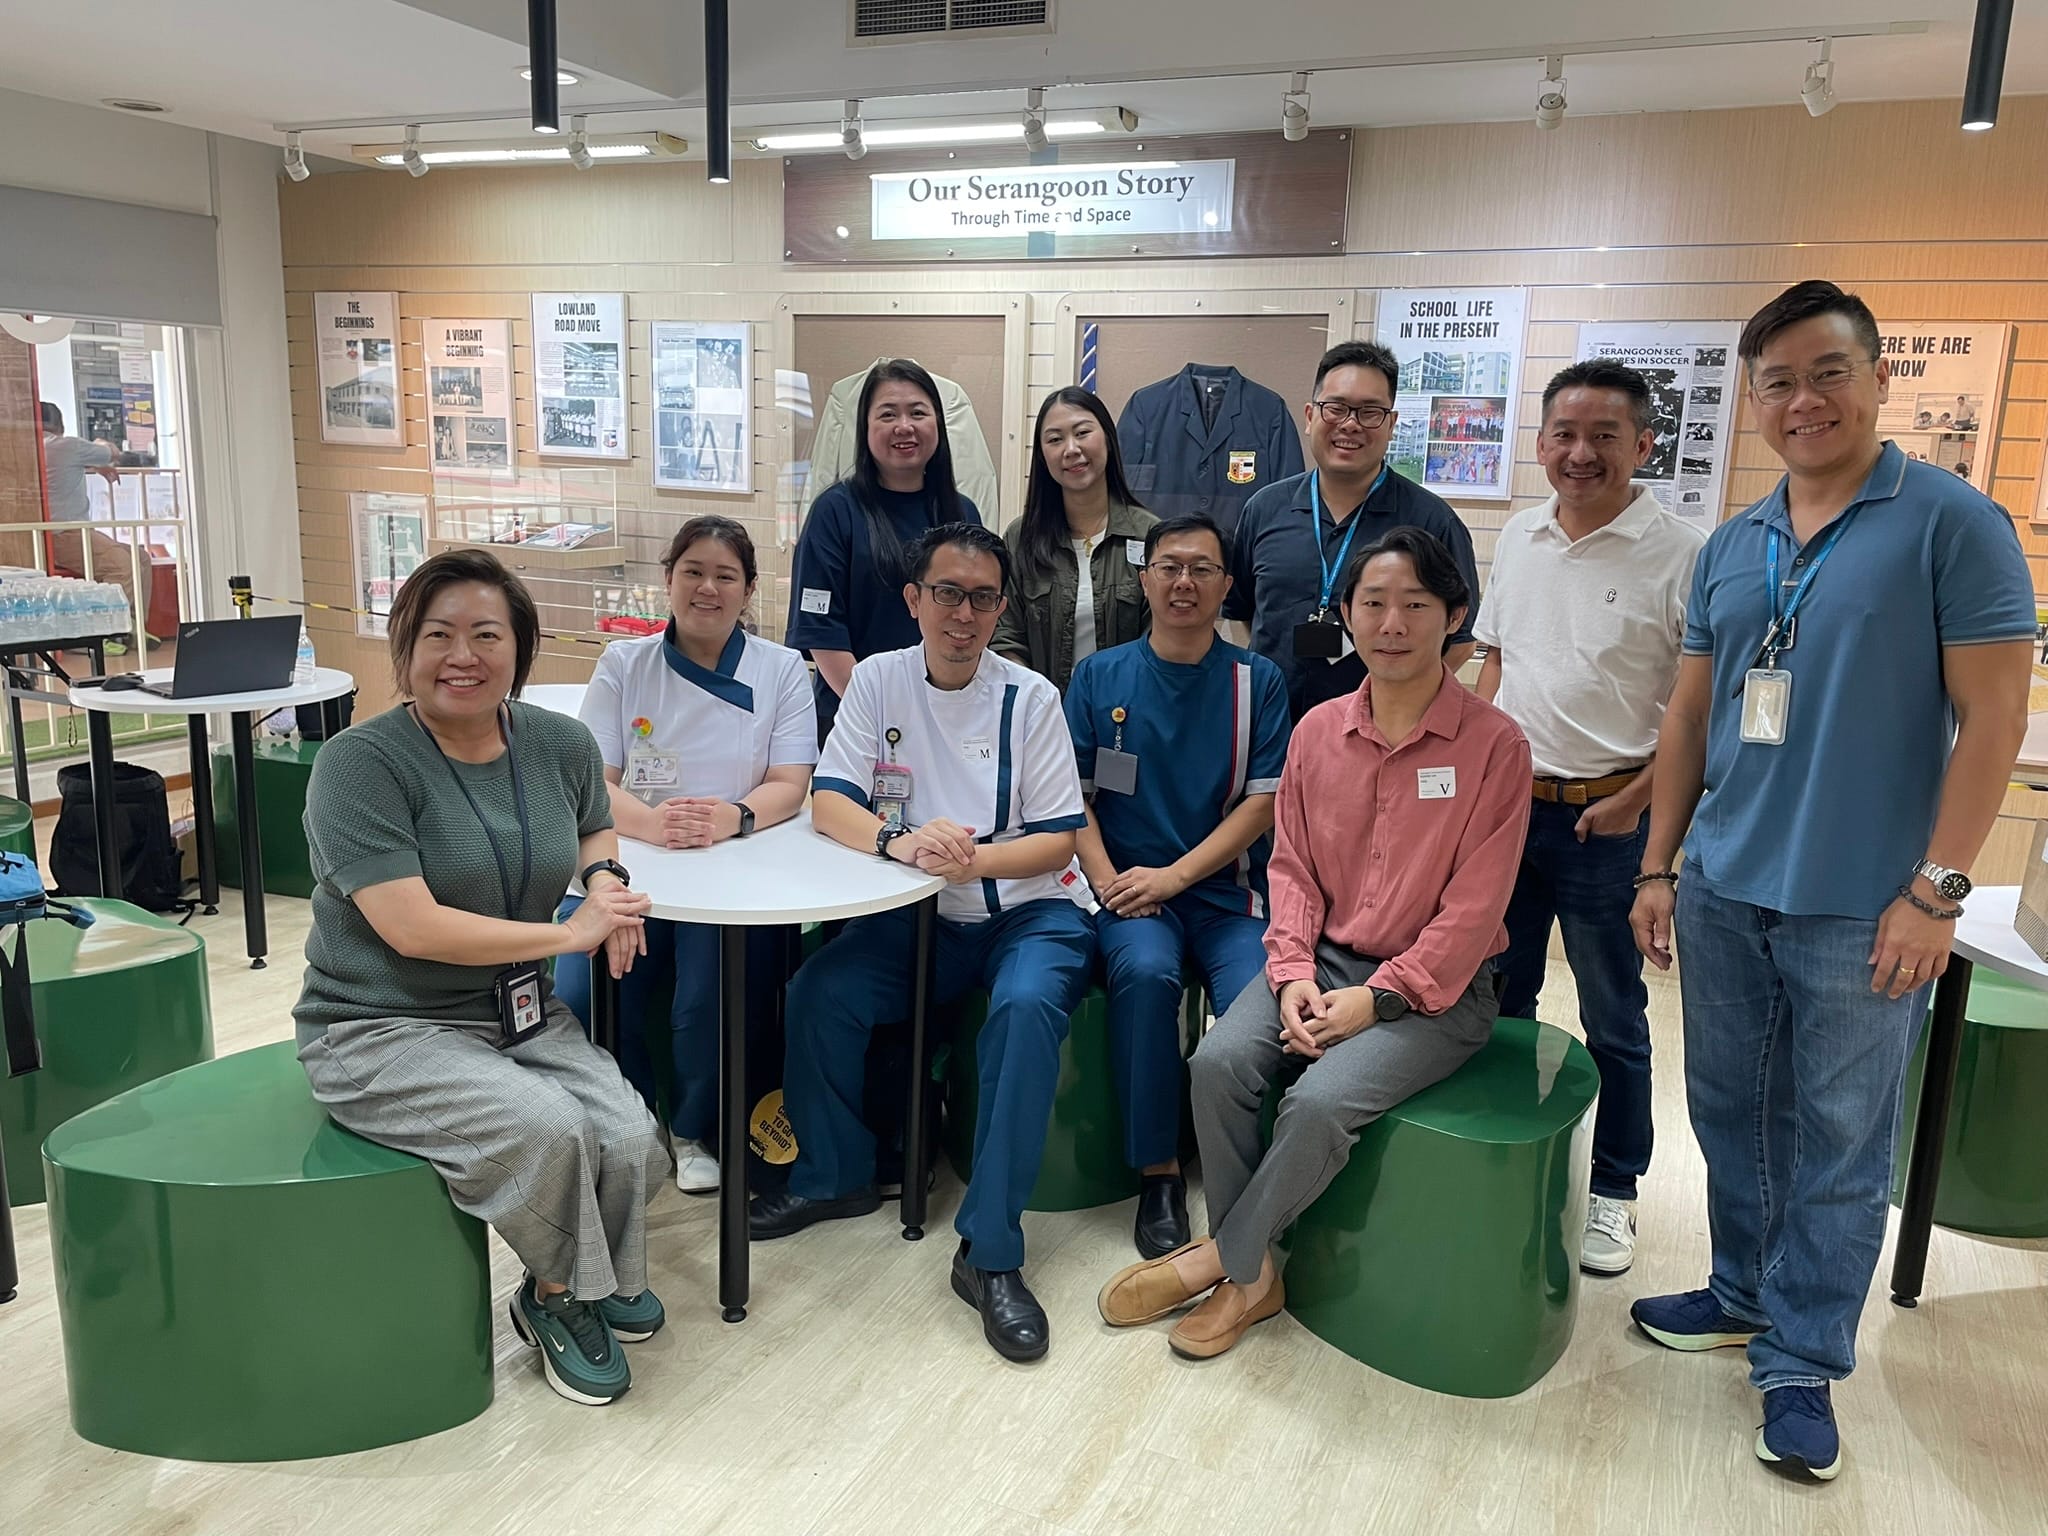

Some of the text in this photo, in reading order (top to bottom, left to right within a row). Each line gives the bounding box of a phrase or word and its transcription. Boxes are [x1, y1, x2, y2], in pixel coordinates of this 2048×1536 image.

[909, 169, 1195, 207] Our Serangoon Story
[952, 210, 1010, 228] Through
[1014, 210, 1050, 224] Time
[1087, 207, 1131, 225] Space
[347, 302, 360, 313] THE
[558, 303, 596, 316] LOWLAND
[1410, 301, 1493, 317] SCHOOL LIFE
[335, 317, 374, 329] BEGINNINGS
[554, 319, 601, 332] ROAD MOVE
[446, 329, 482, 341] A VIBRANT
[1400, 322, 1500, 338] IN THE PRESENT
[446, 345, 484, 357] BEGINNING
[1880, 336, 1972, 354] ERE WE ARE
[1600, 348, 1682, 356] SERANGOON SEC
[1649, 357, 1690, 365] SOCCER
[1889, 360, 1927, 377] NOW
[980, 749, 990, 759] M
[1440, 783, 1450, 795] V
[773, 1115, 785, 1128] TO
[782, 1125, 793, 1138] GO
[760, 1120, 792, 1152] BEYOND?
